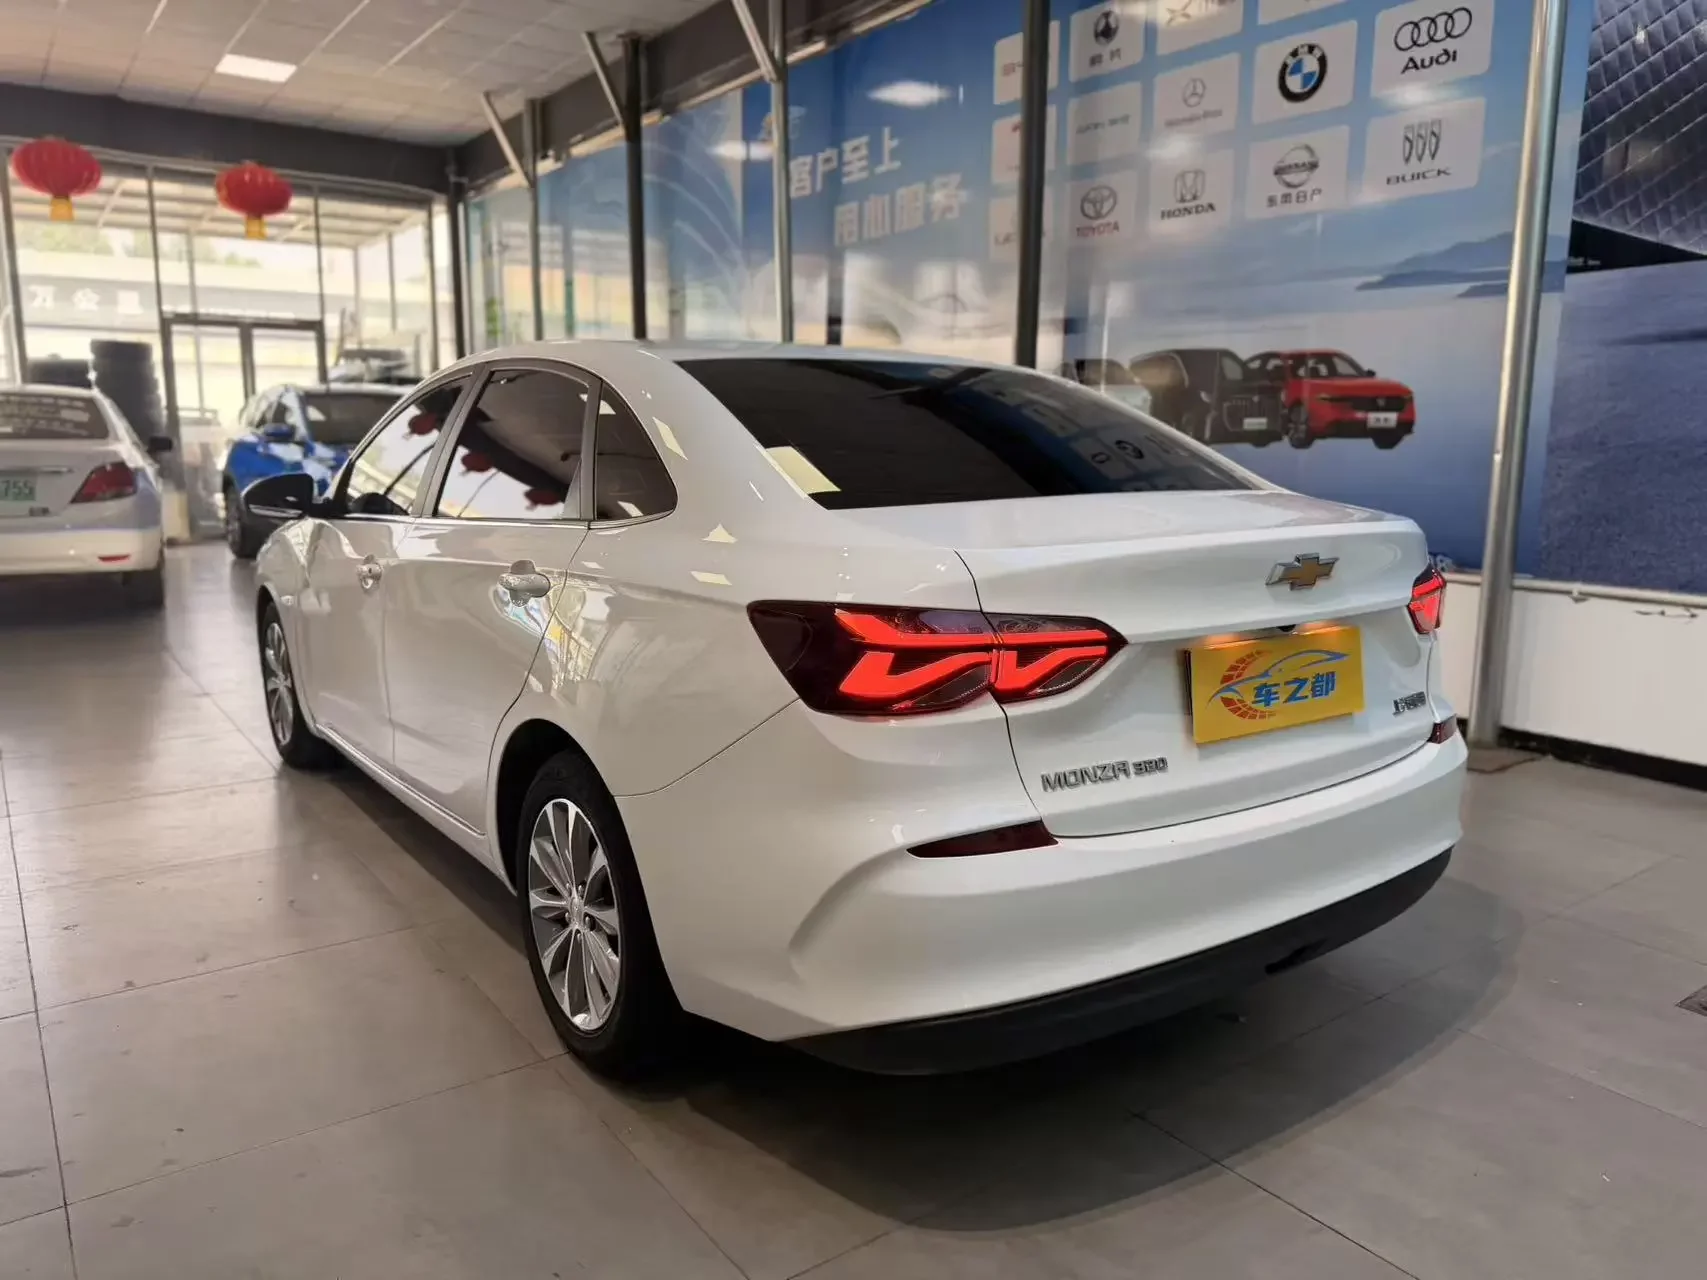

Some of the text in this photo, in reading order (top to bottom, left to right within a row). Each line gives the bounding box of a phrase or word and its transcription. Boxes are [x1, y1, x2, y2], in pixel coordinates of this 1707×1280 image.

[1401, 48, 1458, 75] Audi
[789, 126, 901, 199] 客户至上
[1386, 168, 1452, 186] BUICK
[1160, 202, 1216, 221] HONDA
[1075, 221, 1119, 238] TOYOTA
[1252, 671, 1336, 708] 车之都
[1040, 760, 1131, 792] MONZA
